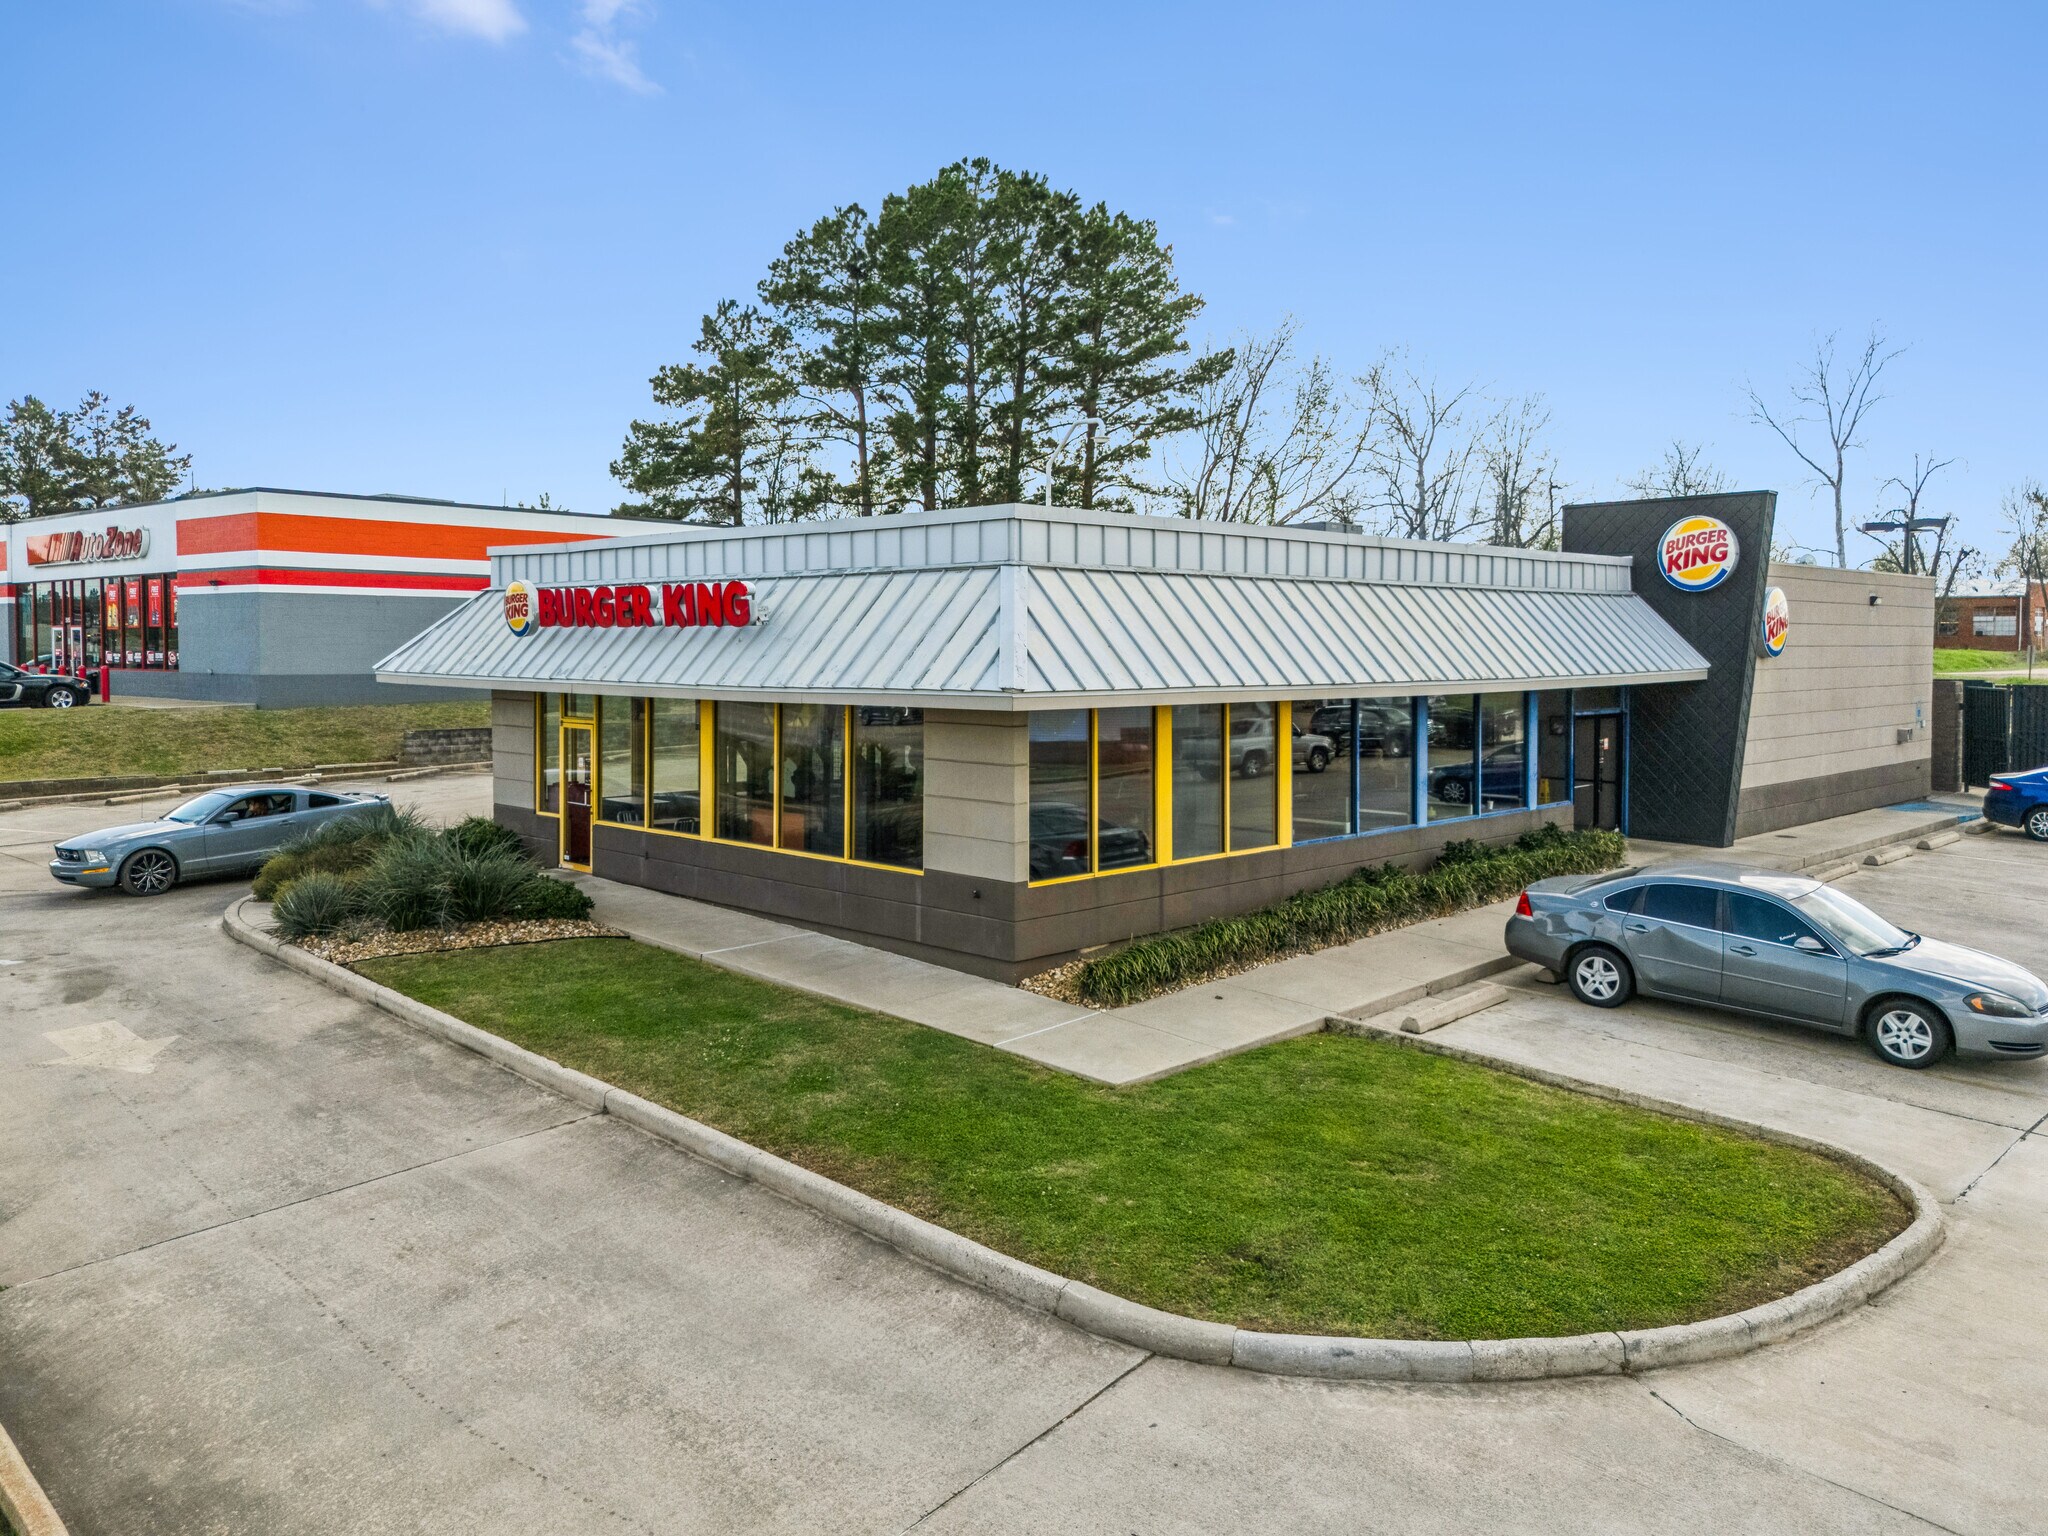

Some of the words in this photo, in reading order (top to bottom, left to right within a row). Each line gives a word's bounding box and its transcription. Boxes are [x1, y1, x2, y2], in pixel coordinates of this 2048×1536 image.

[70, 526, 142, 562] AutoZone
[1665, 529, 1728, 555] BURGER
[1666, 542, 1729, 574] KING
[505, 593, 528, 606] BURGER
[505, 603, 528, 620] KING
[538, 584, 655, 628] BURGER
[662, 580, 751, 628] KING
[1767, 602, 1788, 626] BUR
